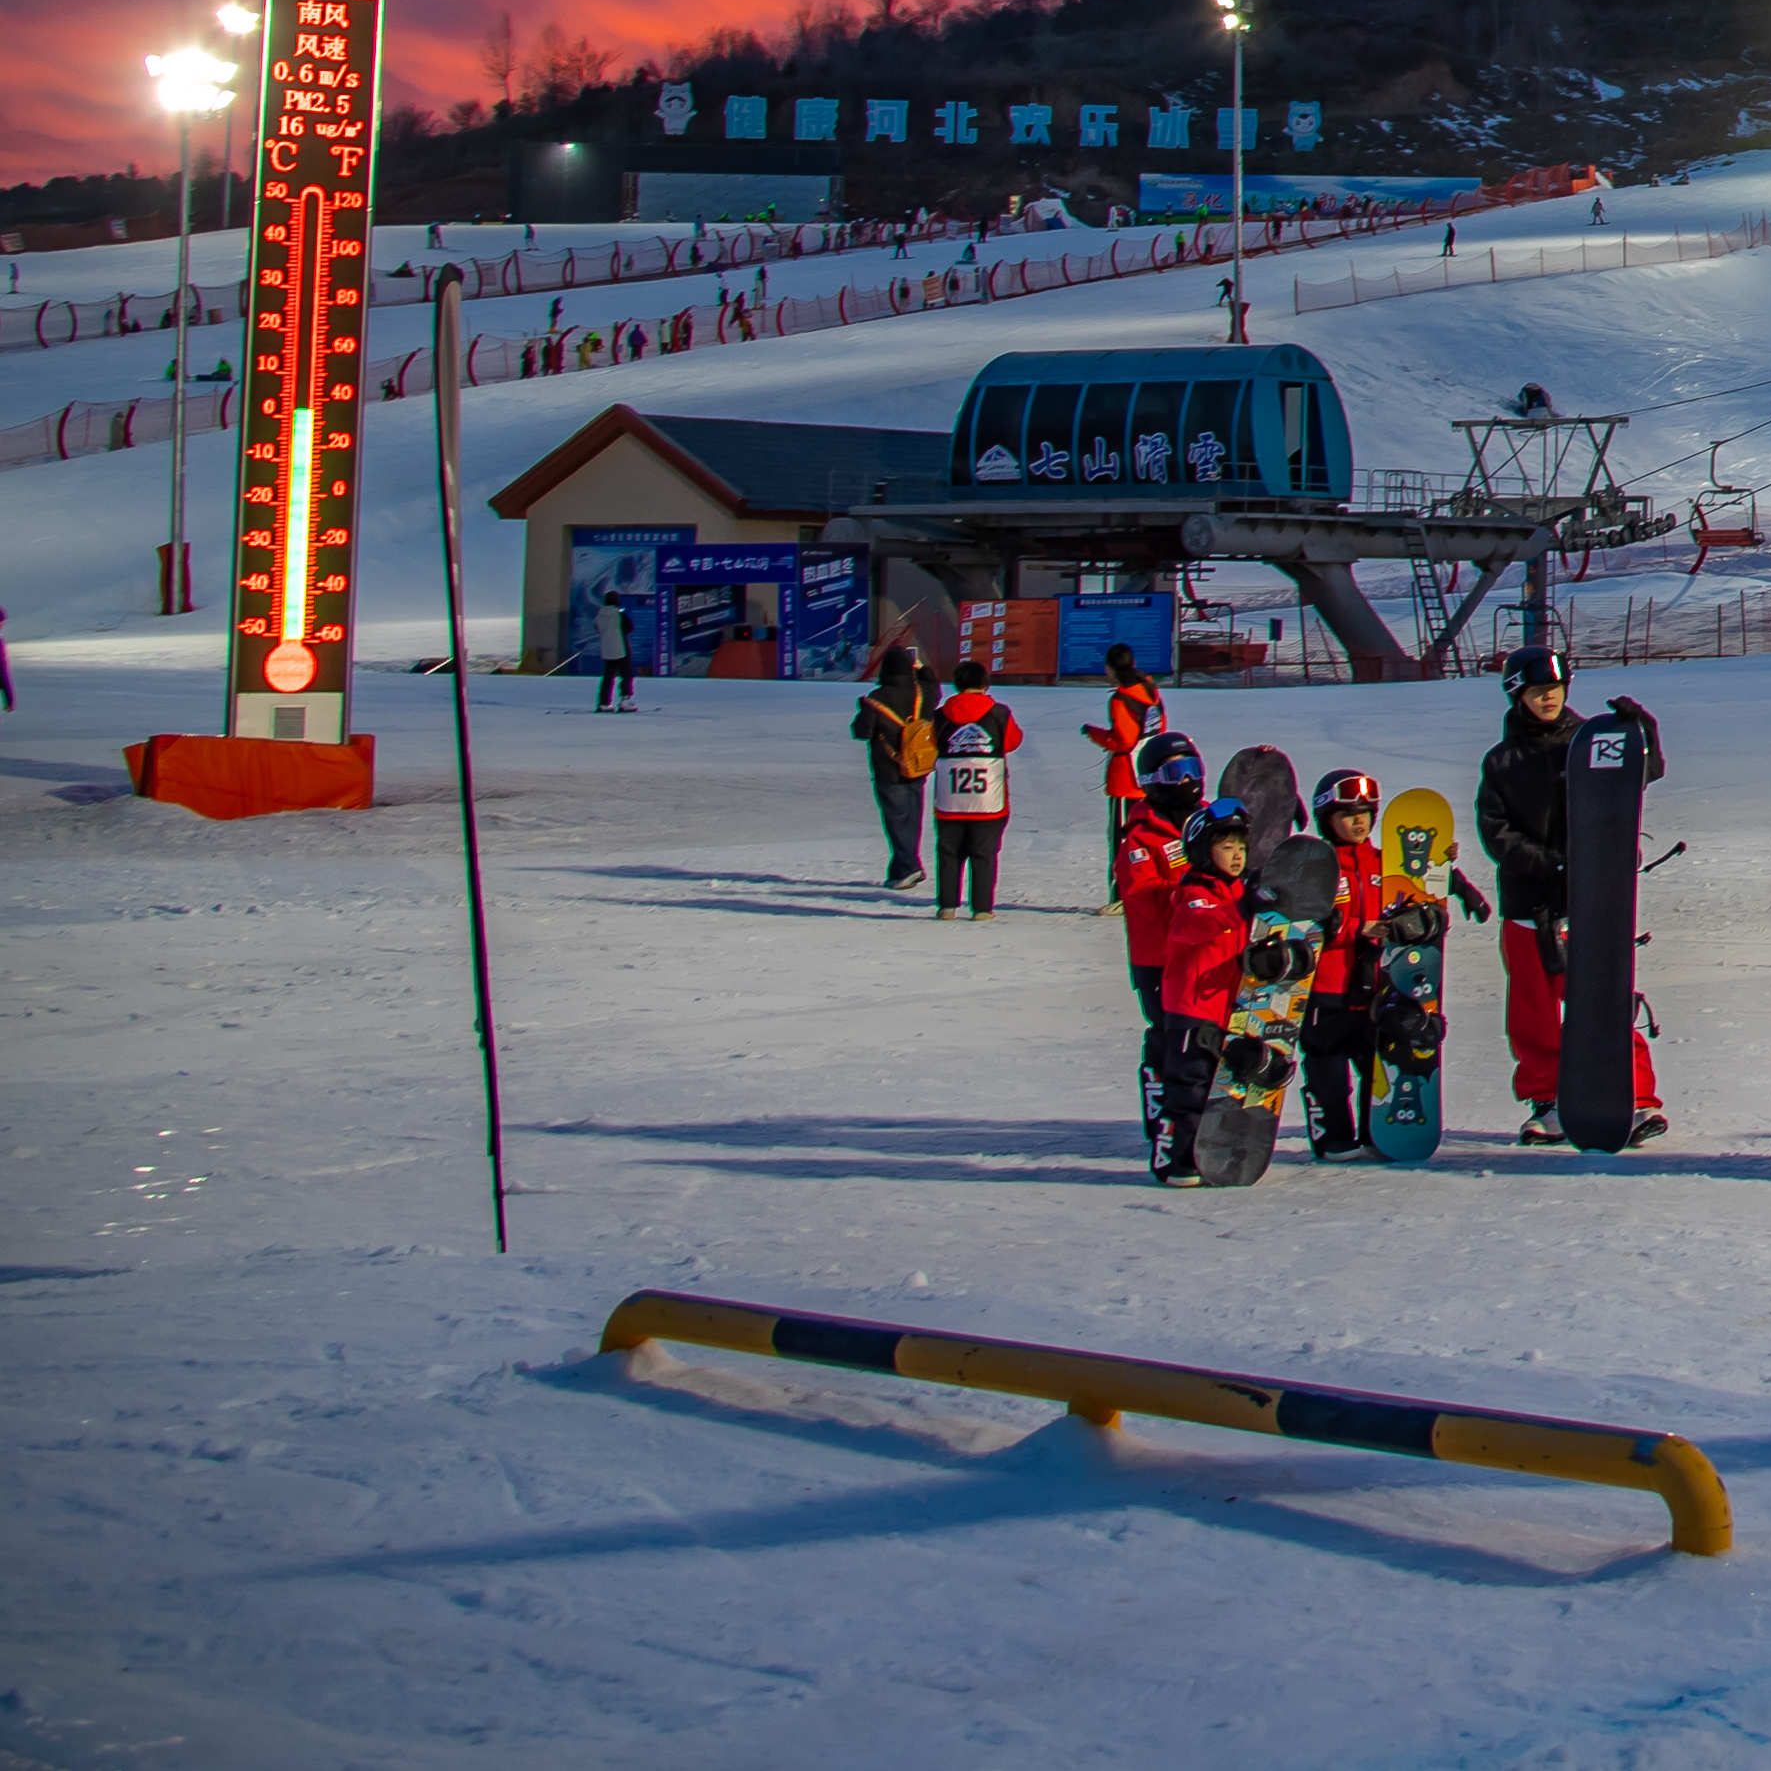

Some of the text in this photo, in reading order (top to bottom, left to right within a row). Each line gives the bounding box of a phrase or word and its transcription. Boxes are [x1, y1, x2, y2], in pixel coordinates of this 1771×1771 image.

[298, 0, 349, 28] 南风
[294, 34, 347, 61] 风速
[284, 90, 351, 115] PM2.5
[278, 116, 304, 136] 16
[264, 181, 288, 199] 50
[333, 192, 363, 208] 120
[263, 225, 287, 242] 40
[331, 239, 361, 256] 100
[260, 269, 284, 285] 30
[335, 289, 358, 306] 80
[258, 312, 282, 329] 20
[333, 337, 355, 354] 60
[257, 355, 279, 372] 10
[330, 384, 353, 401] 40
[262, 398, 276, 415] 0
[328, 432, 351, 449] 20
[245, 443, 275, 459] -10
[1029, 432, 1226, 484] 七山滑雪
[244, 486, 273, 503] -20
[331, 480, 347, 497] 0
[241, 530, 272, 546] -30
[318, 529, 348, 545] -20
[239, 574, 270, 591] -40
[317, 575, 347, 592] -40
[236, 618, 267, 634] -50
[314, 625, 344, 641] -60
[949, 767, 988, 794] 125
[1142, 1066, 1164, 1120] FILA
[1305, 1092, 1327, 1141] FILA
[1153, 1117, 1175, 1169] FILA
